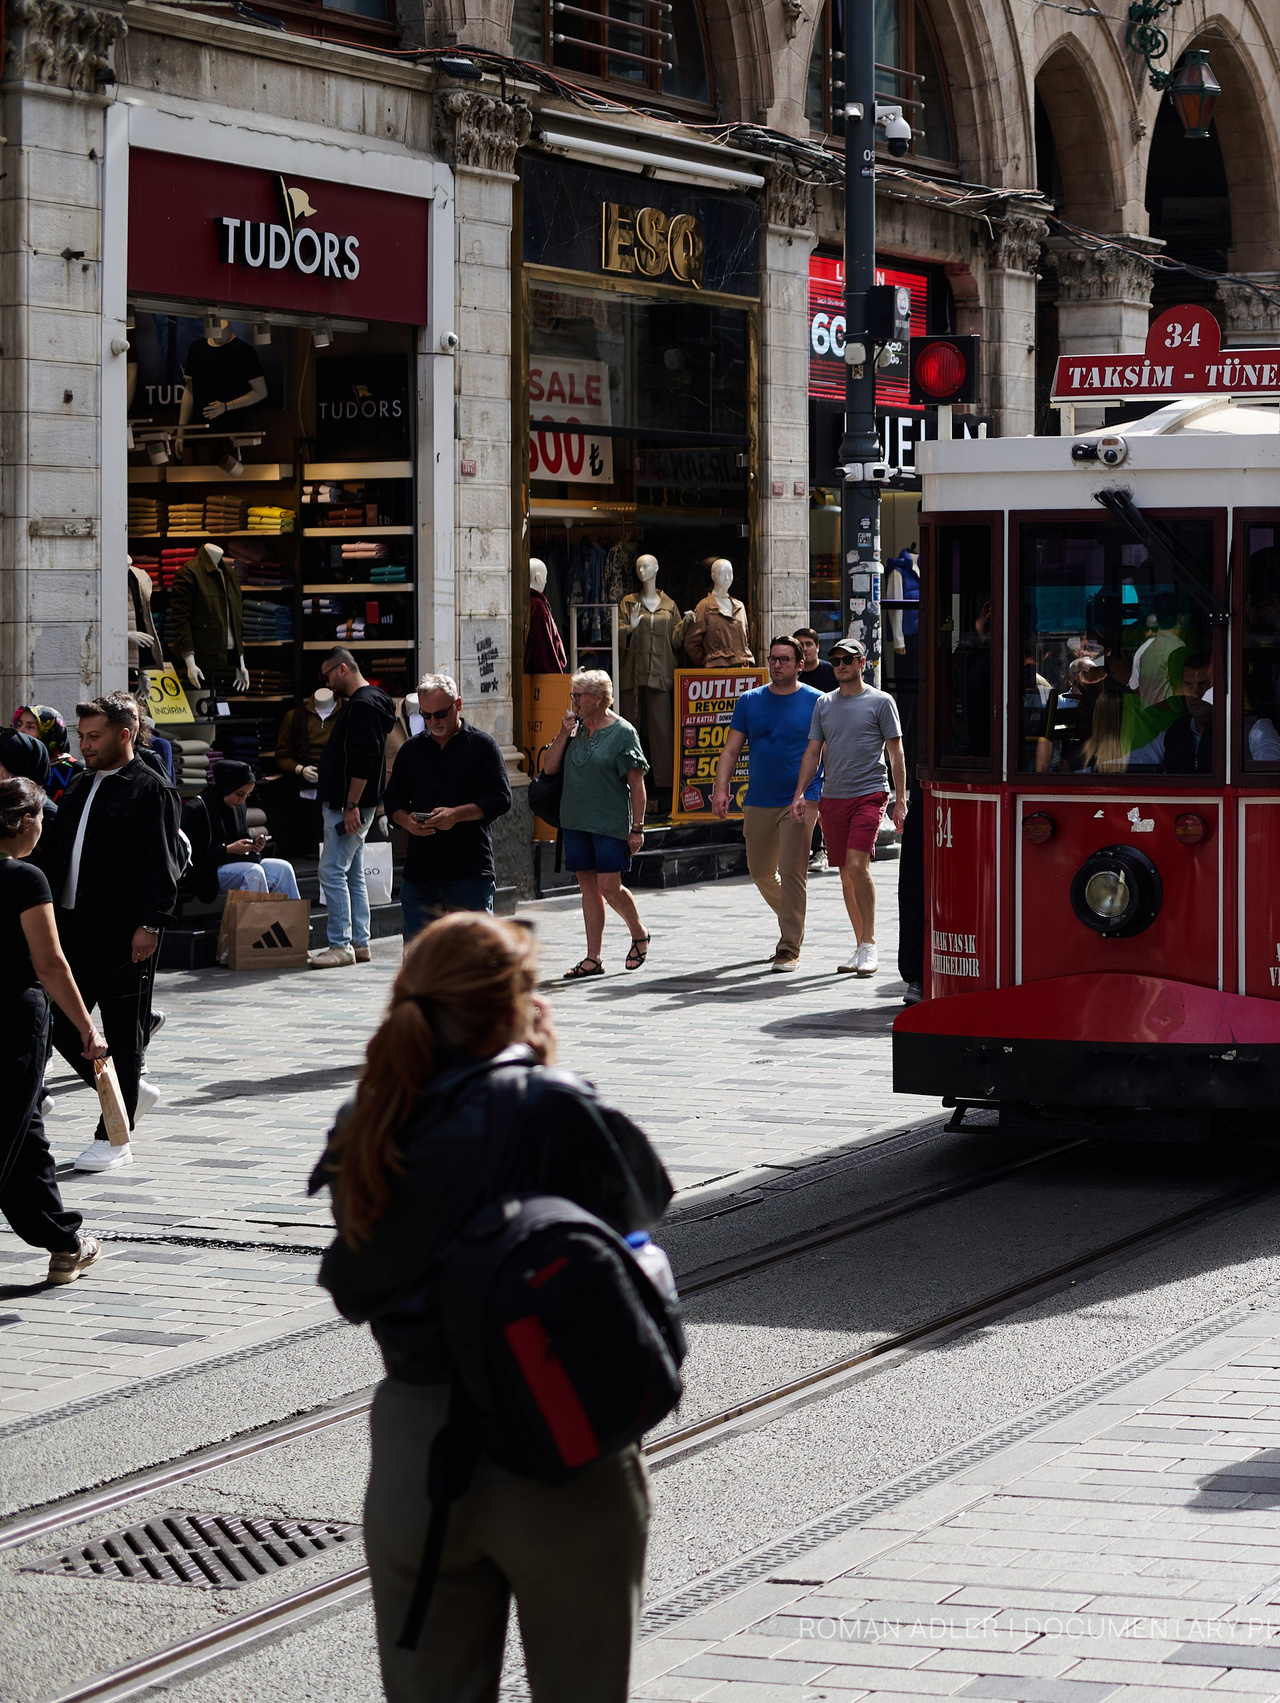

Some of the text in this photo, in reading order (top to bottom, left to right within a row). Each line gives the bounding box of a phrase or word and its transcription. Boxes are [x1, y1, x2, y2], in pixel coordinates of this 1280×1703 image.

[221, 216, 361, 281] TUDORS
[602, 201, 705, 290] ESQ
[1164, 322, 1201, 348] 34
[1068, 359, 1175, 388] TAKSİM
[145, 384, 187, 405] TUD
[529, 368, 603, 406] SALE
[318, 399, 402, 420] TUDORS
[688, 677, 757, 700] OUTLET
[695, 700, 736, 712] REYON
[936, 805, 953, 848] 34
[948, 932, 977, 954] YASAK
